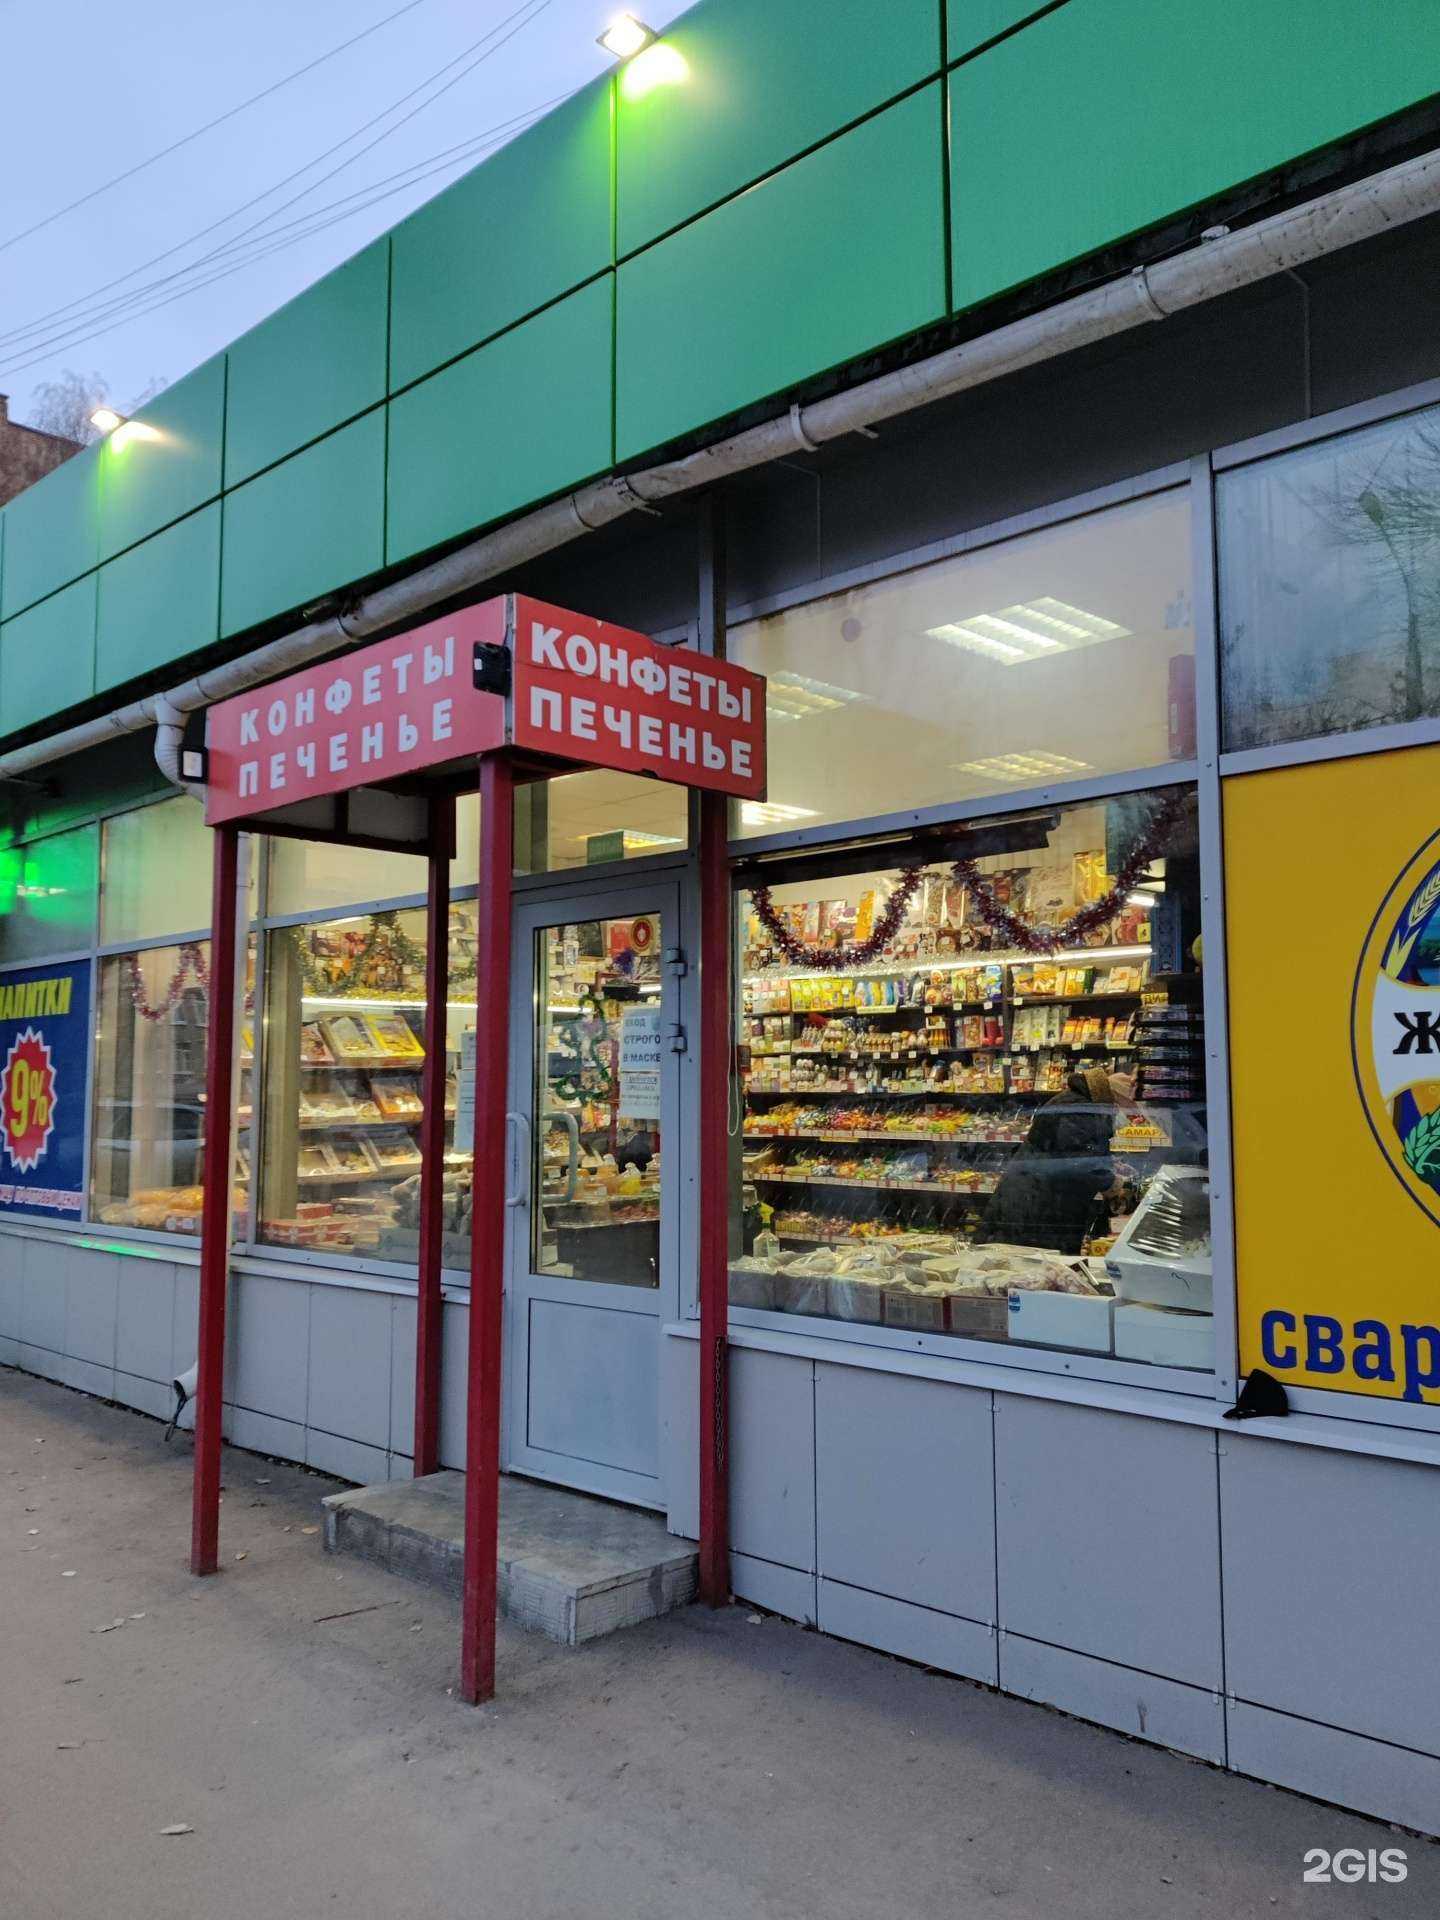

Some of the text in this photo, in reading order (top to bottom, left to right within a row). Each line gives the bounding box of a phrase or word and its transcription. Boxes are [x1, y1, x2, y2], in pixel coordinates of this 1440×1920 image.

[240, 637, 455, 746] КОНФЕТЫ
[531, 621, 751, 724] КОНФЕТЫ
[239, 698, 453, 798] ПЕЧЕНЬЕ
[530, 685, 752, 778] ПЕЧЕНЬЕ
[624, 1034, 661, 1045] СТРОГО
[630, 1053, 661, 1063] МАСКЕ
[10, 1058, 48, 1137] 9%
